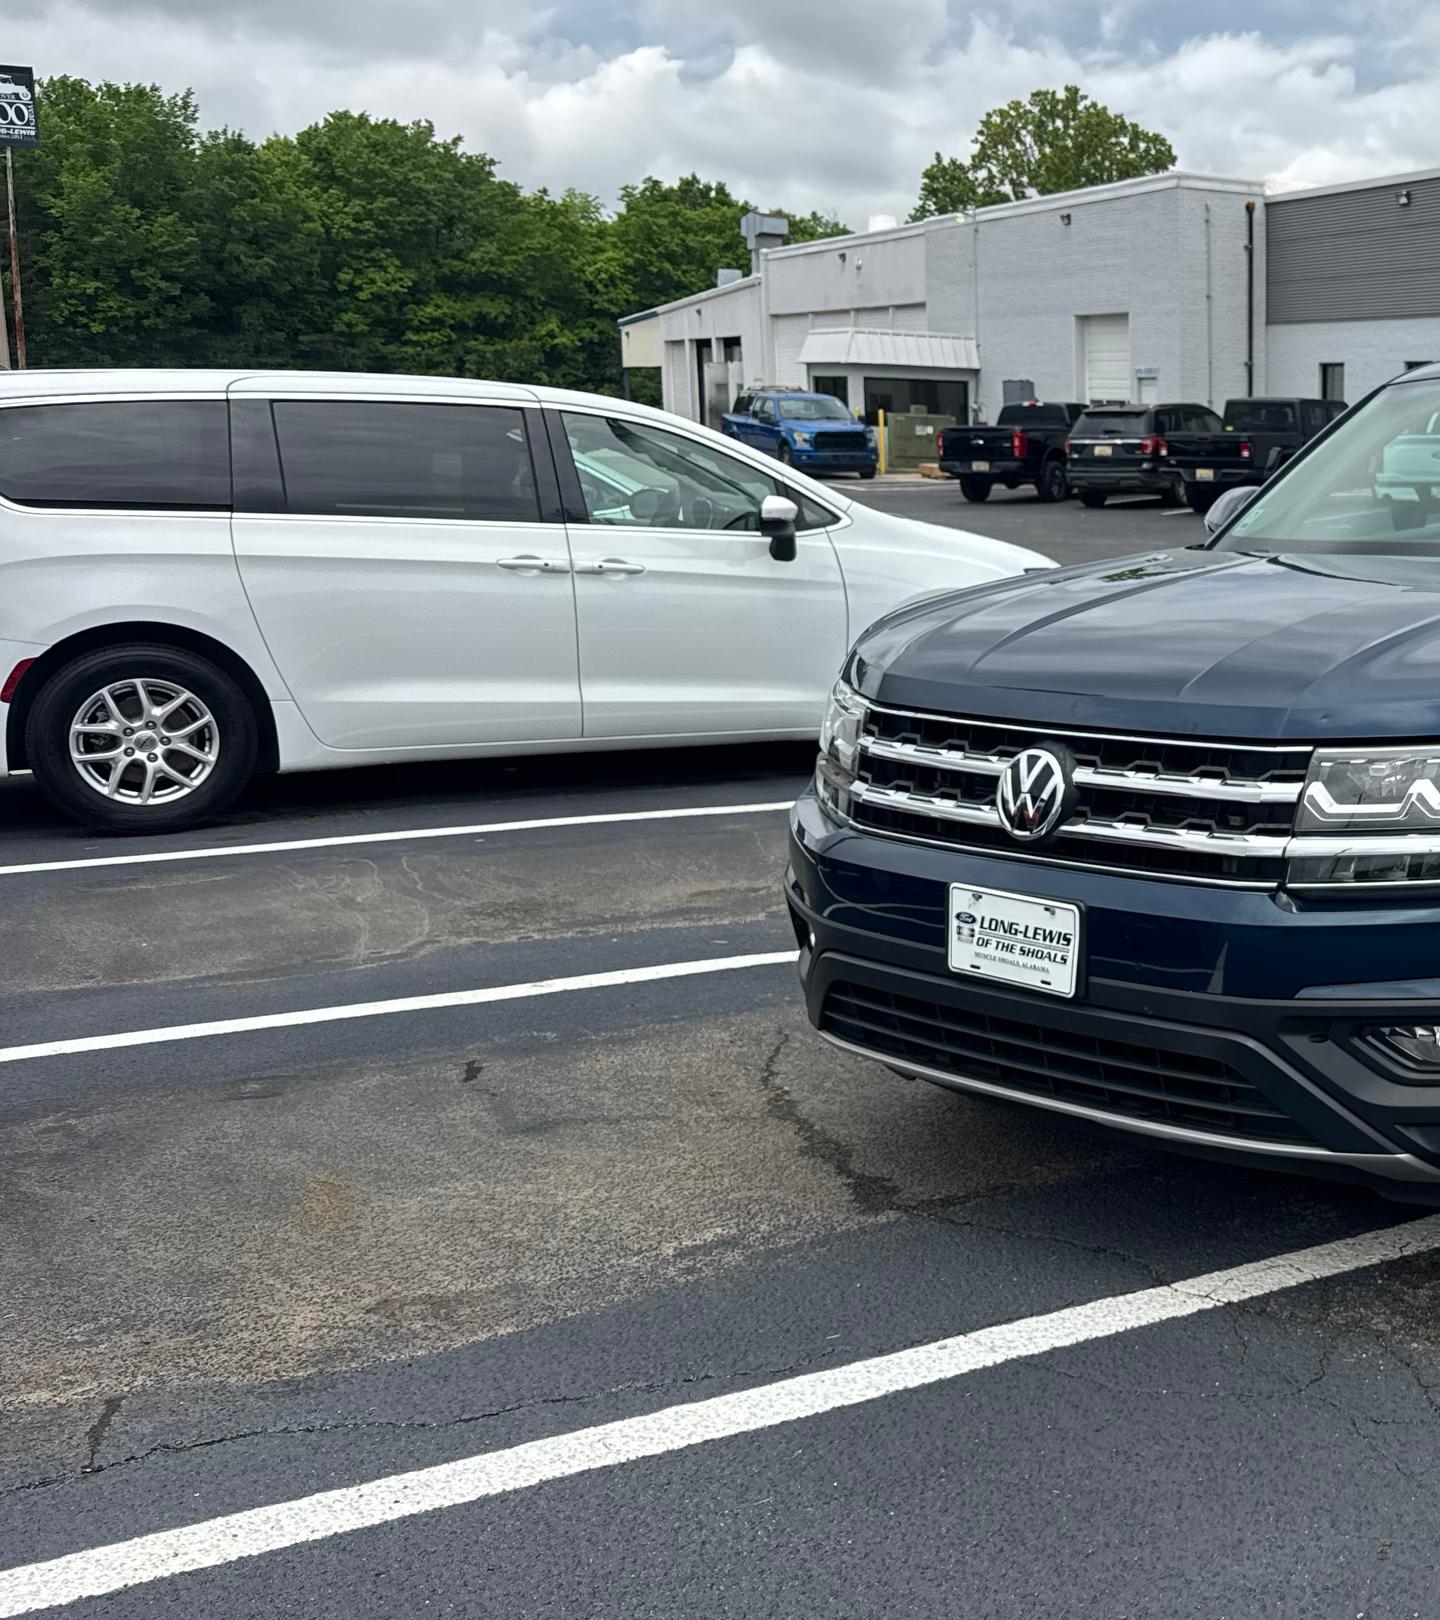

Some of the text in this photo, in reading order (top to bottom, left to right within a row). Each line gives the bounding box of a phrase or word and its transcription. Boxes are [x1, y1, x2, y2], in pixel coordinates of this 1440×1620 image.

[979, 915, 1073, 946] LONG-LEWIS
[976, 936, 1068, 965] OF THE SHOALS
